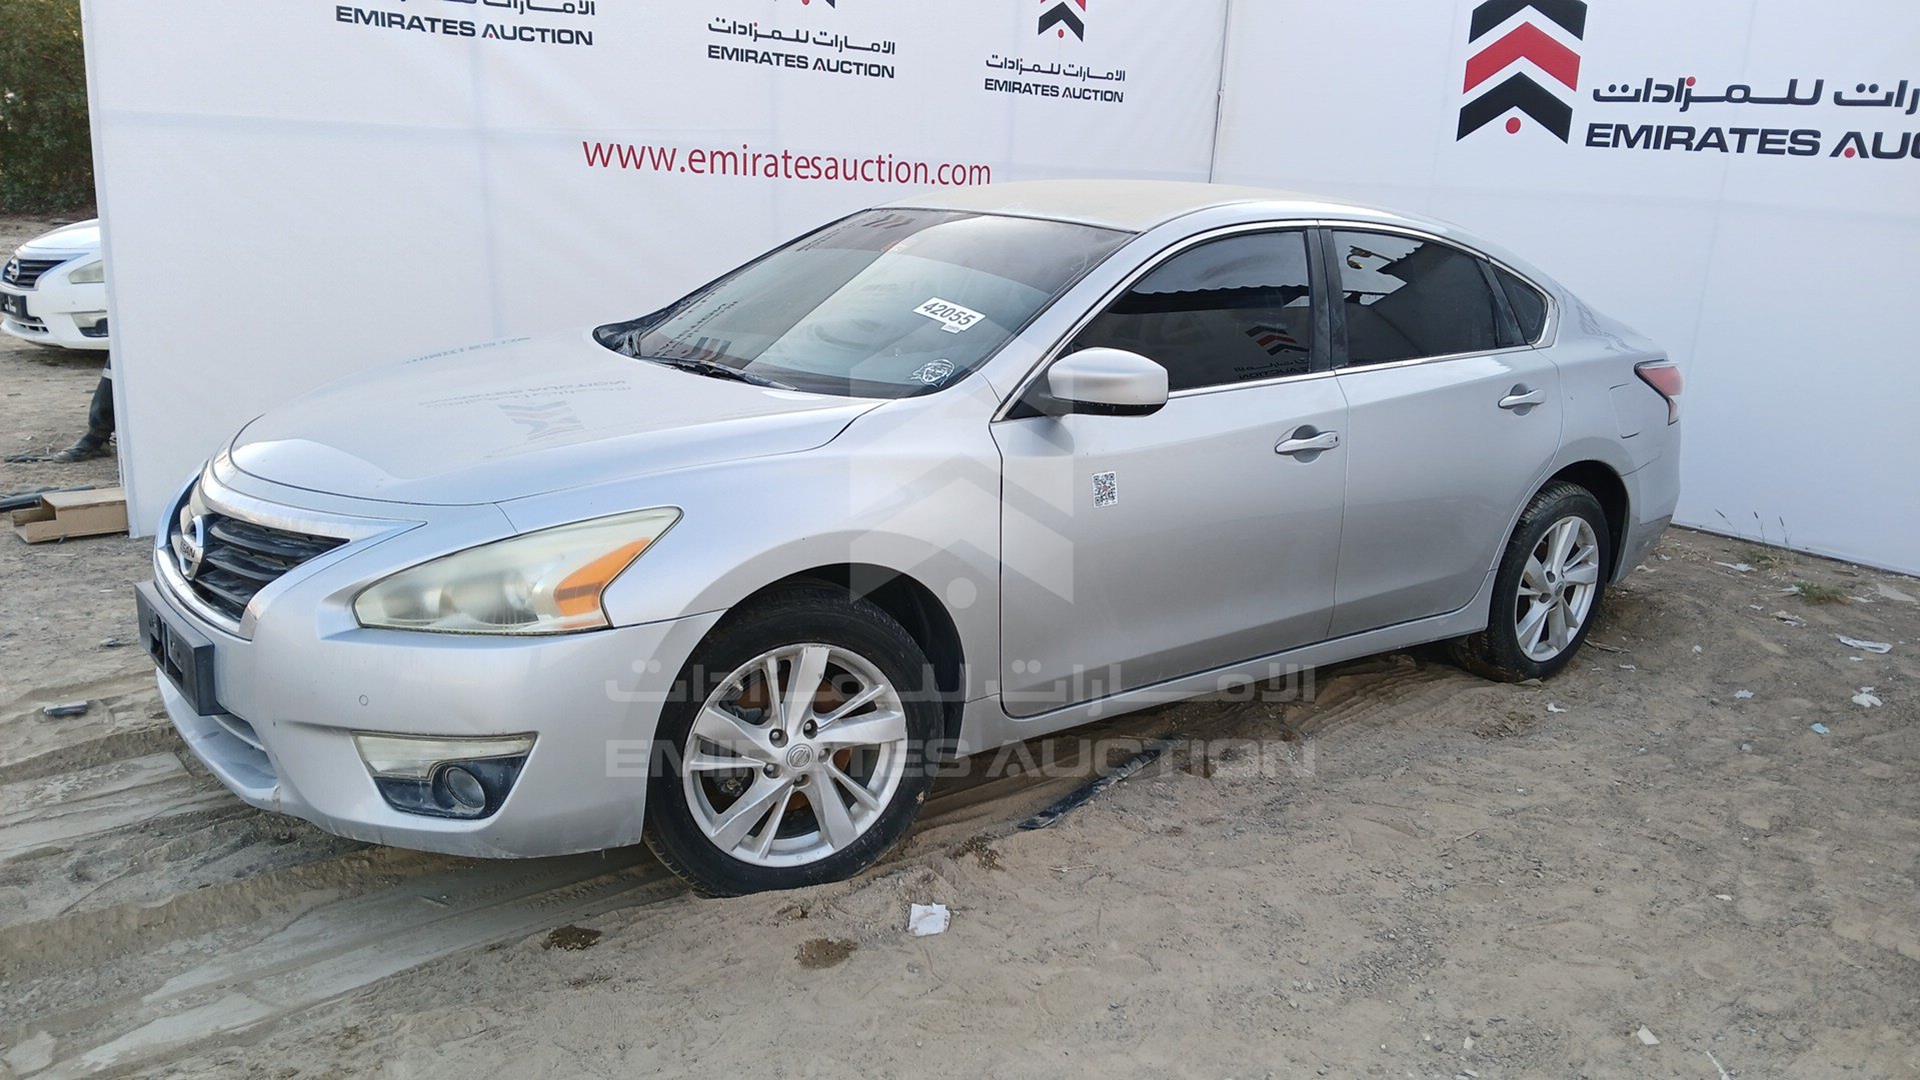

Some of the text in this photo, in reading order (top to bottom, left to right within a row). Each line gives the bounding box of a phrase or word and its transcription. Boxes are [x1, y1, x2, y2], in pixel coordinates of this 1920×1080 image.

[336, 5, 593, 46] EMIRATES AUCTION
[707, 44, 895, 79] EMIRATES AUCTION
[984, 78, 1124, 103] EMIRATES AUCTION
[1592, 76, 1824, 113] للمزادات
[1585, 122, 1821, 157] EMIRATES
[582, 140, 992, 186] www.emiratesauction.com
[923, 302, 976, 326] 42055
